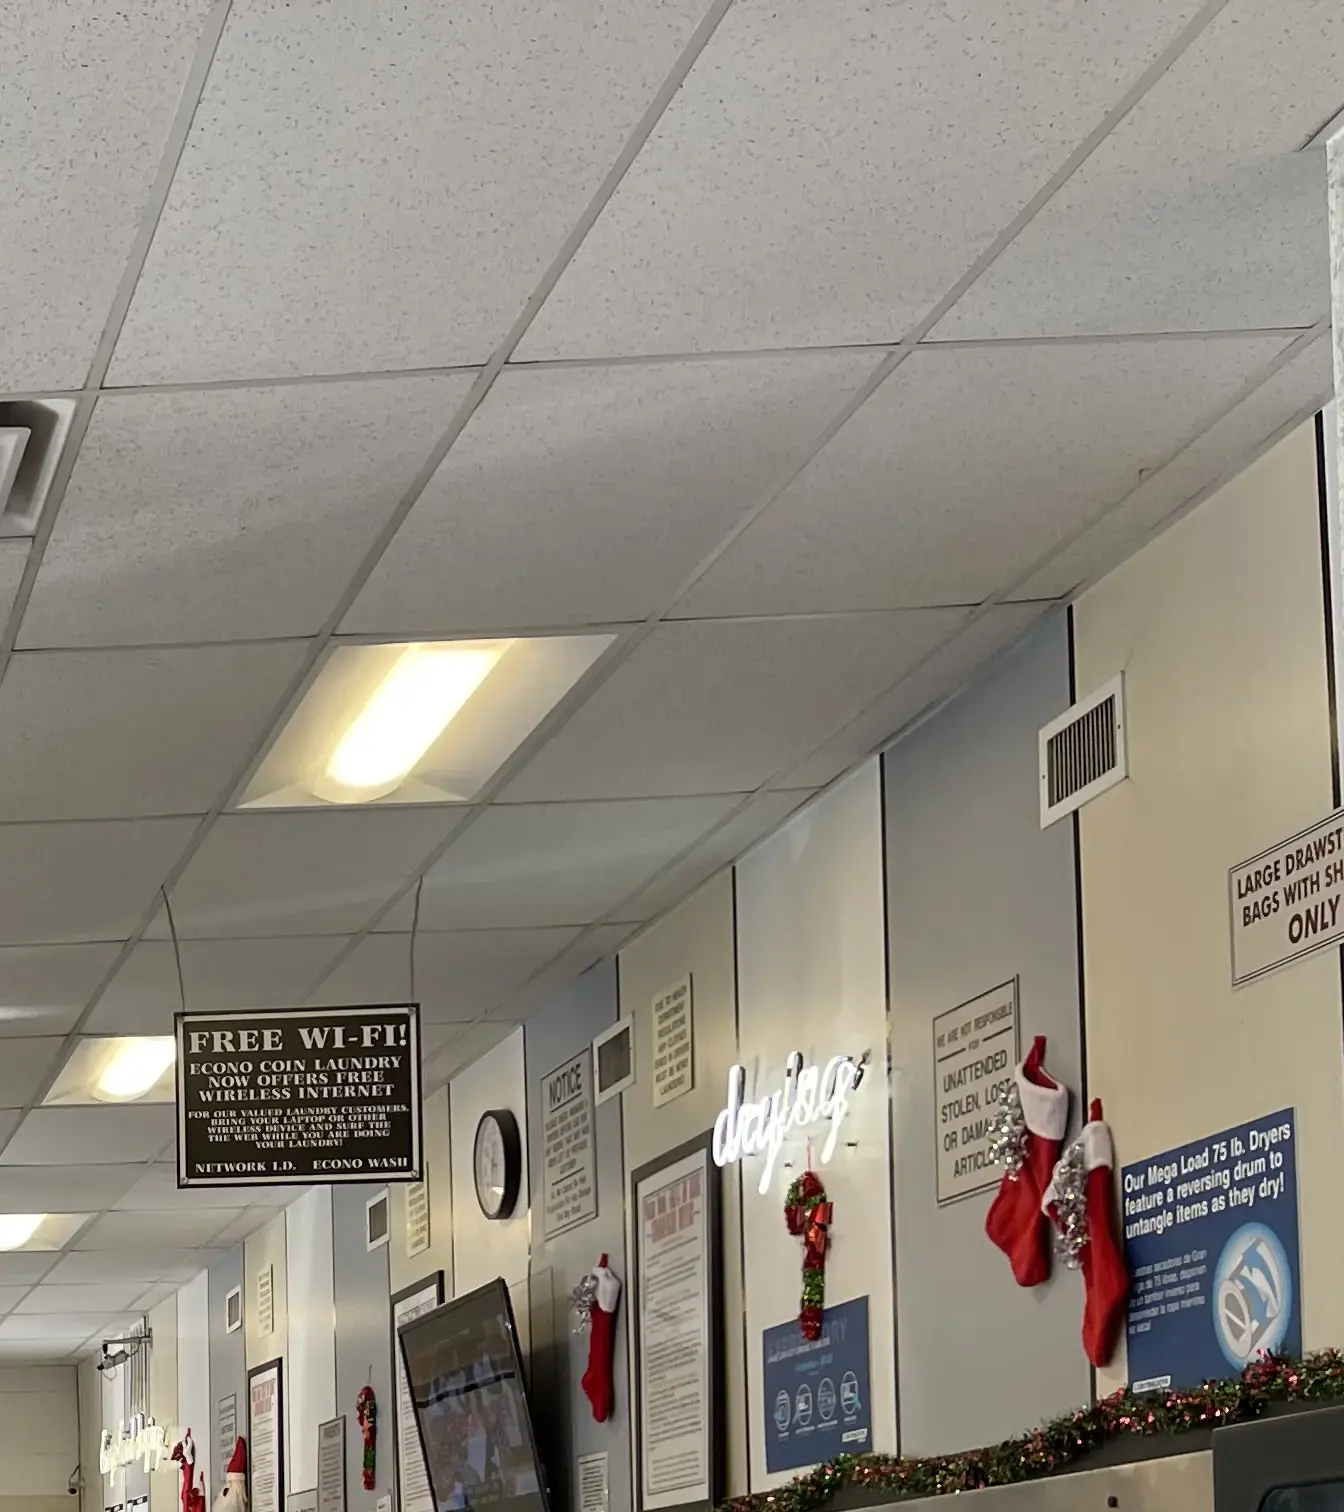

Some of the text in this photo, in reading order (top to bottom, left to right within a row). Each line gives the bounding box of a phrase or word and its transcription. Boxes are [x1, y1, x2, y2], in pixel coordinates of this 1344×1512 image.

[1237, 827, 1342, 900] LARGE DRAWST
[1243, 891, 1280, 927] BAGS
[1283, 871, 1320, 907] WITH
[1288, 894, 1341, 944] ONLY
[189, 1024, 408, 1054] FREE WI-FI!
[190, 1056, 402, 1075] ECONO COIN LAUNDRY
[943, 1049, 1008, 1093] UNATTENDED
[199, 1084, 395, 1102] WIRELESS INTERNET
[208, 1070, 385, 1089] NOW OFFERS FREE
[549, 1063, 582, 1107] NOTICE
[188, 1110, 210, 1119] FOR
[213, 1109, 237, 1118] OUR
[241, 1108, 283, 1118] VALUED
[286, 1106, 338, 1116] LAUNDRY
[211, 1118, 247, 1126] BRING
[250, 1116, 279, 1125] YOUR
[283, 1115, 326, 1124] LAPTOP
[348, 1113, 387, 1122] OTHER
[941, 1092, 982, 1124] STOLEN,
[207, 1120, 392, 1134] WIRELESS DEVICE AND SURF THE
[208, 1134, 231, 1142] THE
[262, 1132, 299, 1141] WHILE
[302, 1131, 324, 1140] YOU
[327, 1130, 350, 1139] ARE
[354, 1129, 390, 1137] DOING
[943, 1128, 959, 1152] OR
[255, 1141, 284, 1149] YOUR
[1124, 1122, 1291, 1193] Our Mega Load 75 lb. Dryers
[195, 1157, 408, 1173] NETWORK I.D. ECONO WASH
[1124, 1150, 1283, 1217] feature a reversing drum to
[1126, 1171, 1285, 1240] untangle items as they dry!
